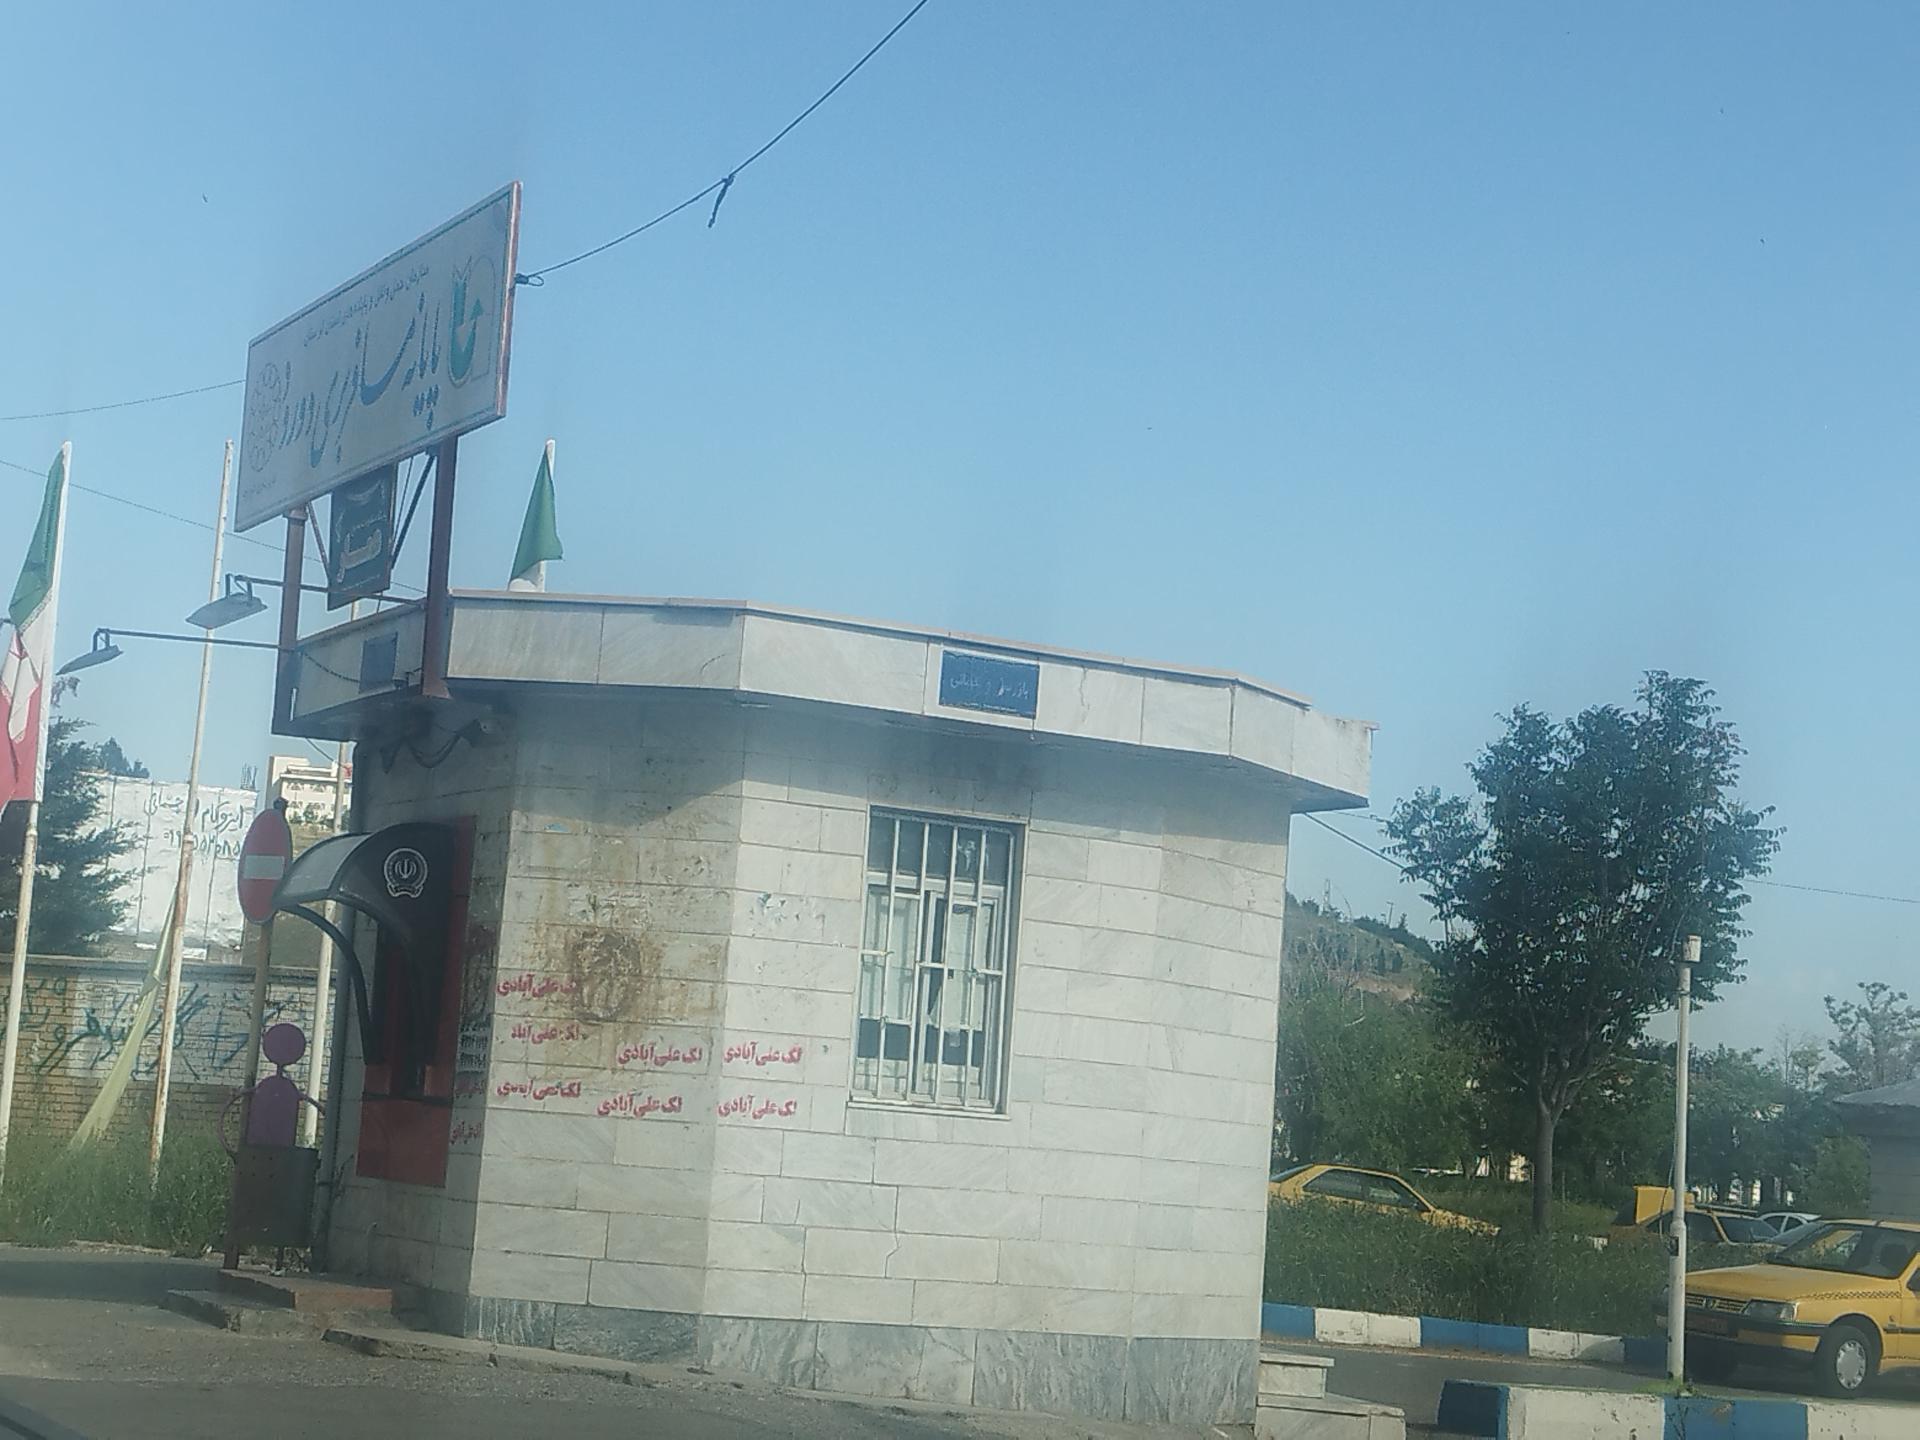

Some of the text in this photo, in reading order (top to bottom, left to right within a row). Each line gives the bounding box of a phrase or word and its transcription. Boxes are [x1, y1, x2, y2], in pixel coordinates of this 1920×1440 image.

[401, 291, 442, 431] پایانه
[309, 316, 416, 468] مسافربری
[496, 974, 536, 998] آبادی
[532, 976, 559, 998] علی
[531, 1023, 560, 1045] علی
[617, 1042, 703, 1067] لک علی آبادی
[723, 1041, 802, 1067] لک علی آبادی
[596, 1092, 683, 1119] لک علی آبادی
[717, 1095, 798, 1120] لک علی آبادی
